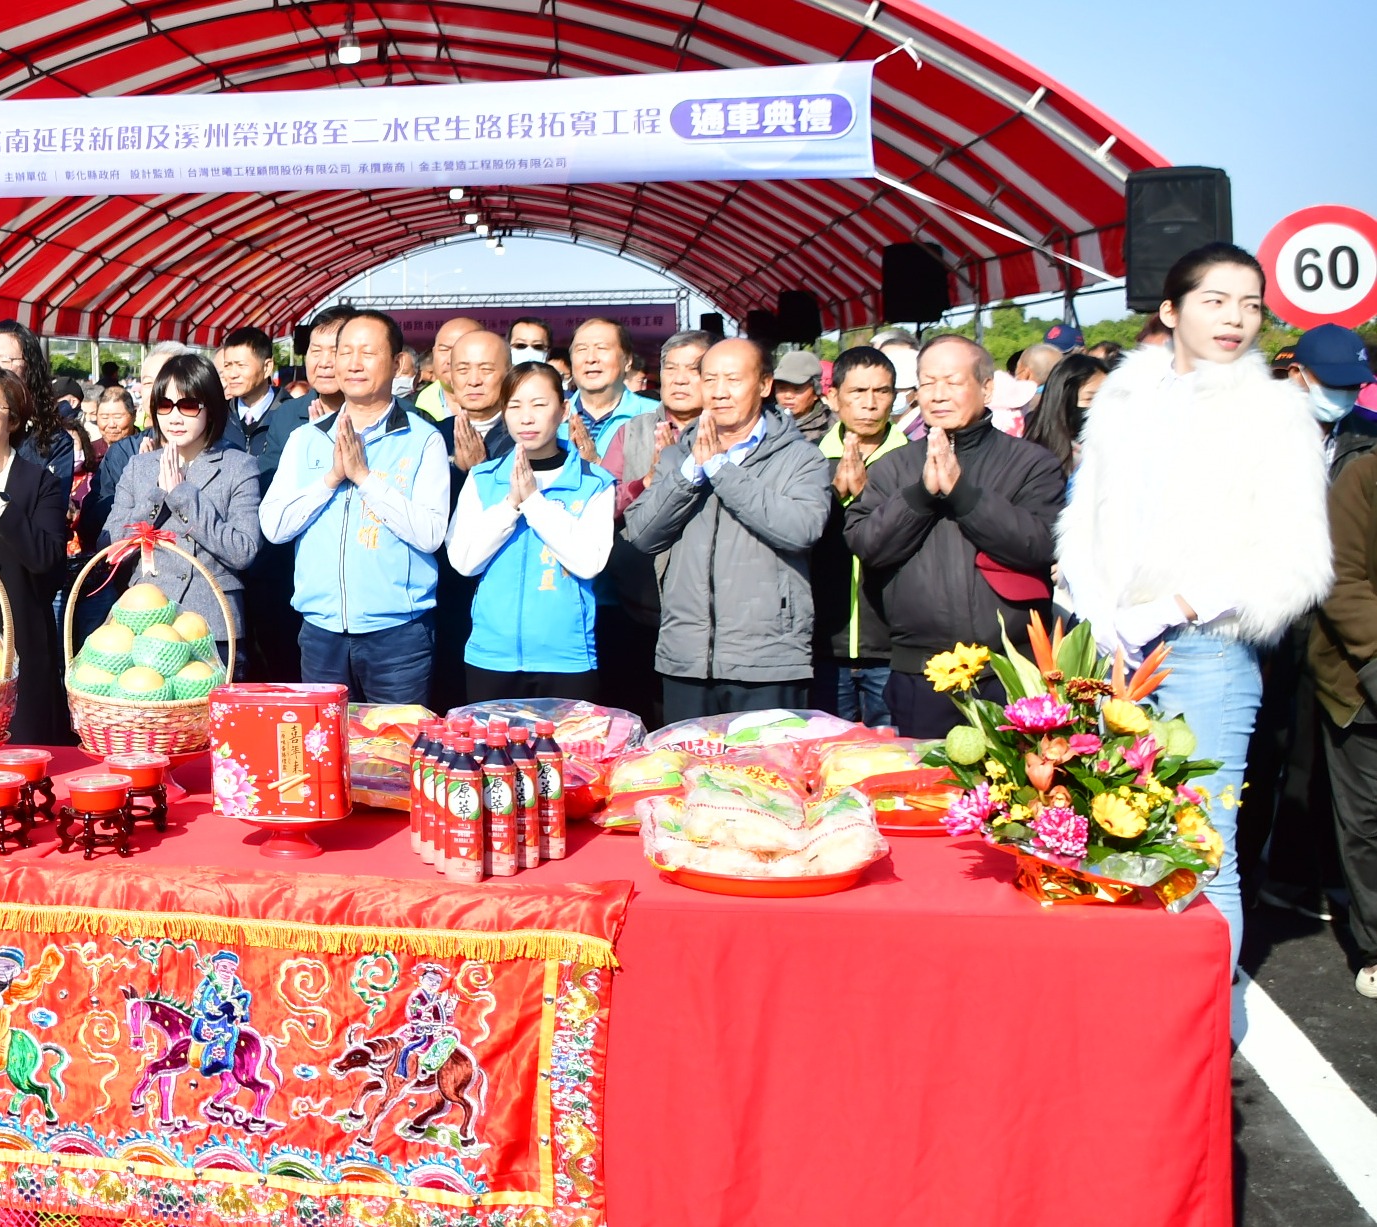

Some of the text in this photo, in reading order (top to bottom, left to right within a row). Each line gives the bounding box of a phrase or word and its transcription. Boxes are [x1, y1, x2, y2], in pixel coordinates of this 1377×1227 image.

[690, 97, 833, 136] 通車典禮
[4, 170, 48, 182] 主辦單位
[65, 169, 120, 181] 彰化縣政府
[130, 168, 175, 180] 設計監造
[358, 161, 406, 174] 承攬廠商
[1293, 245, 1359, 293] 60
[453, 782, 472, 821] 原萃
[487, 777, 505, 816] 原萃
